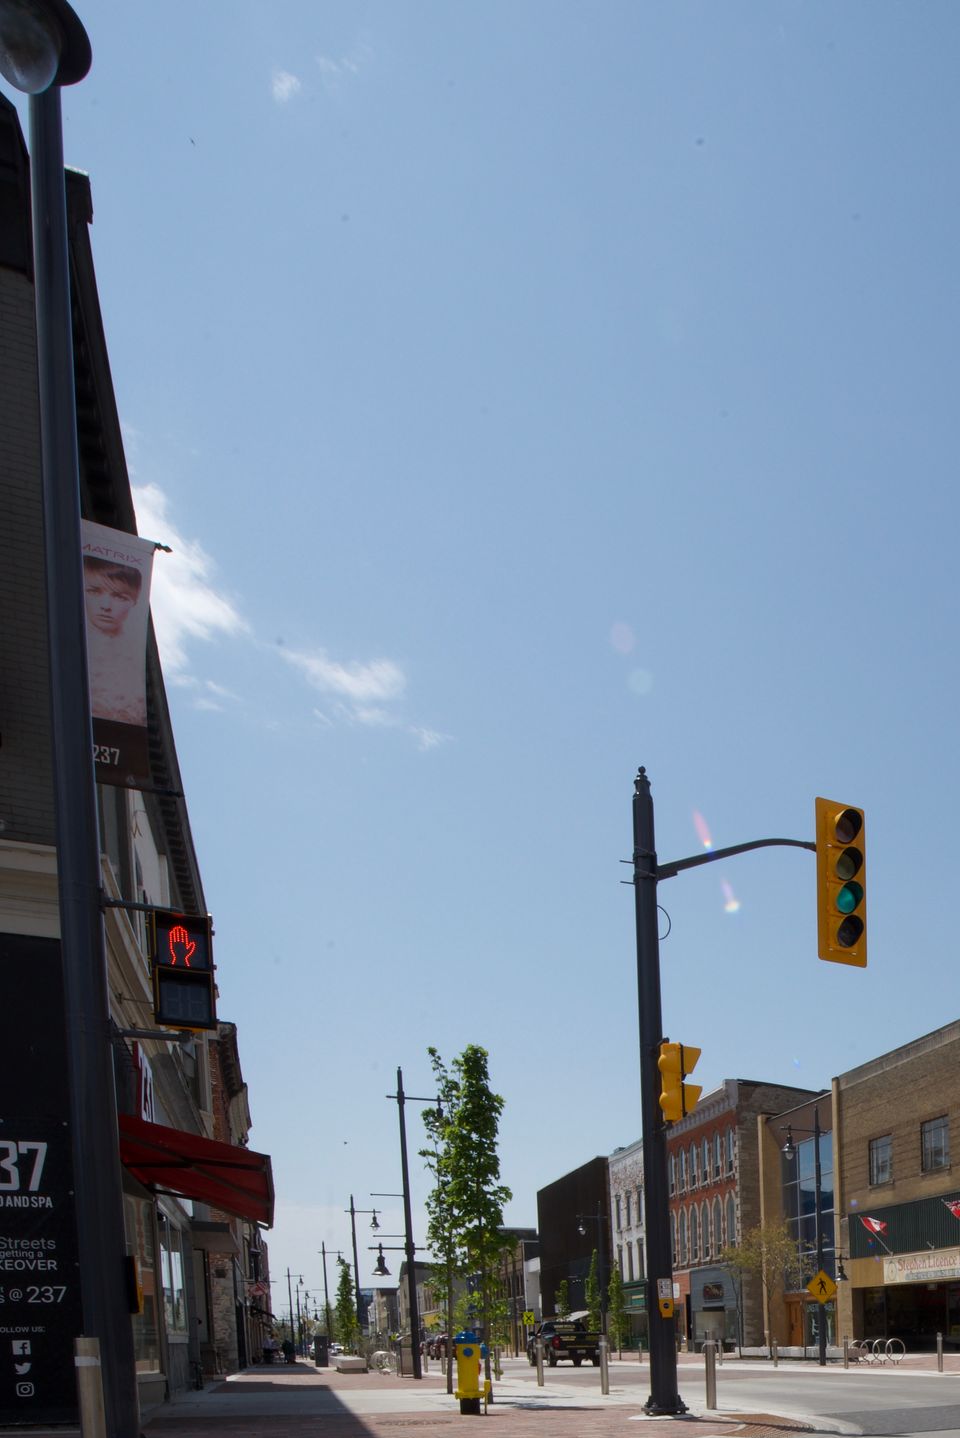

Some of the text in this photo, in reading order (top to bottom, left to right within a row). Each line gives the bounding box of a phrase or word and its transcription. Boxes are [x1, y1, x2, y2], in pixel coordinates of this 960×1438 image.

[92, 744, 120, 766] 237
[6, 1195, 30, 1208] AND
[30, 1196, 53, 1208] SPA
[0, 1236, 56, 1250] Streets
[898, 1259, 927, 1272] Stephen
[26, 1286, 67, 1303] 237
